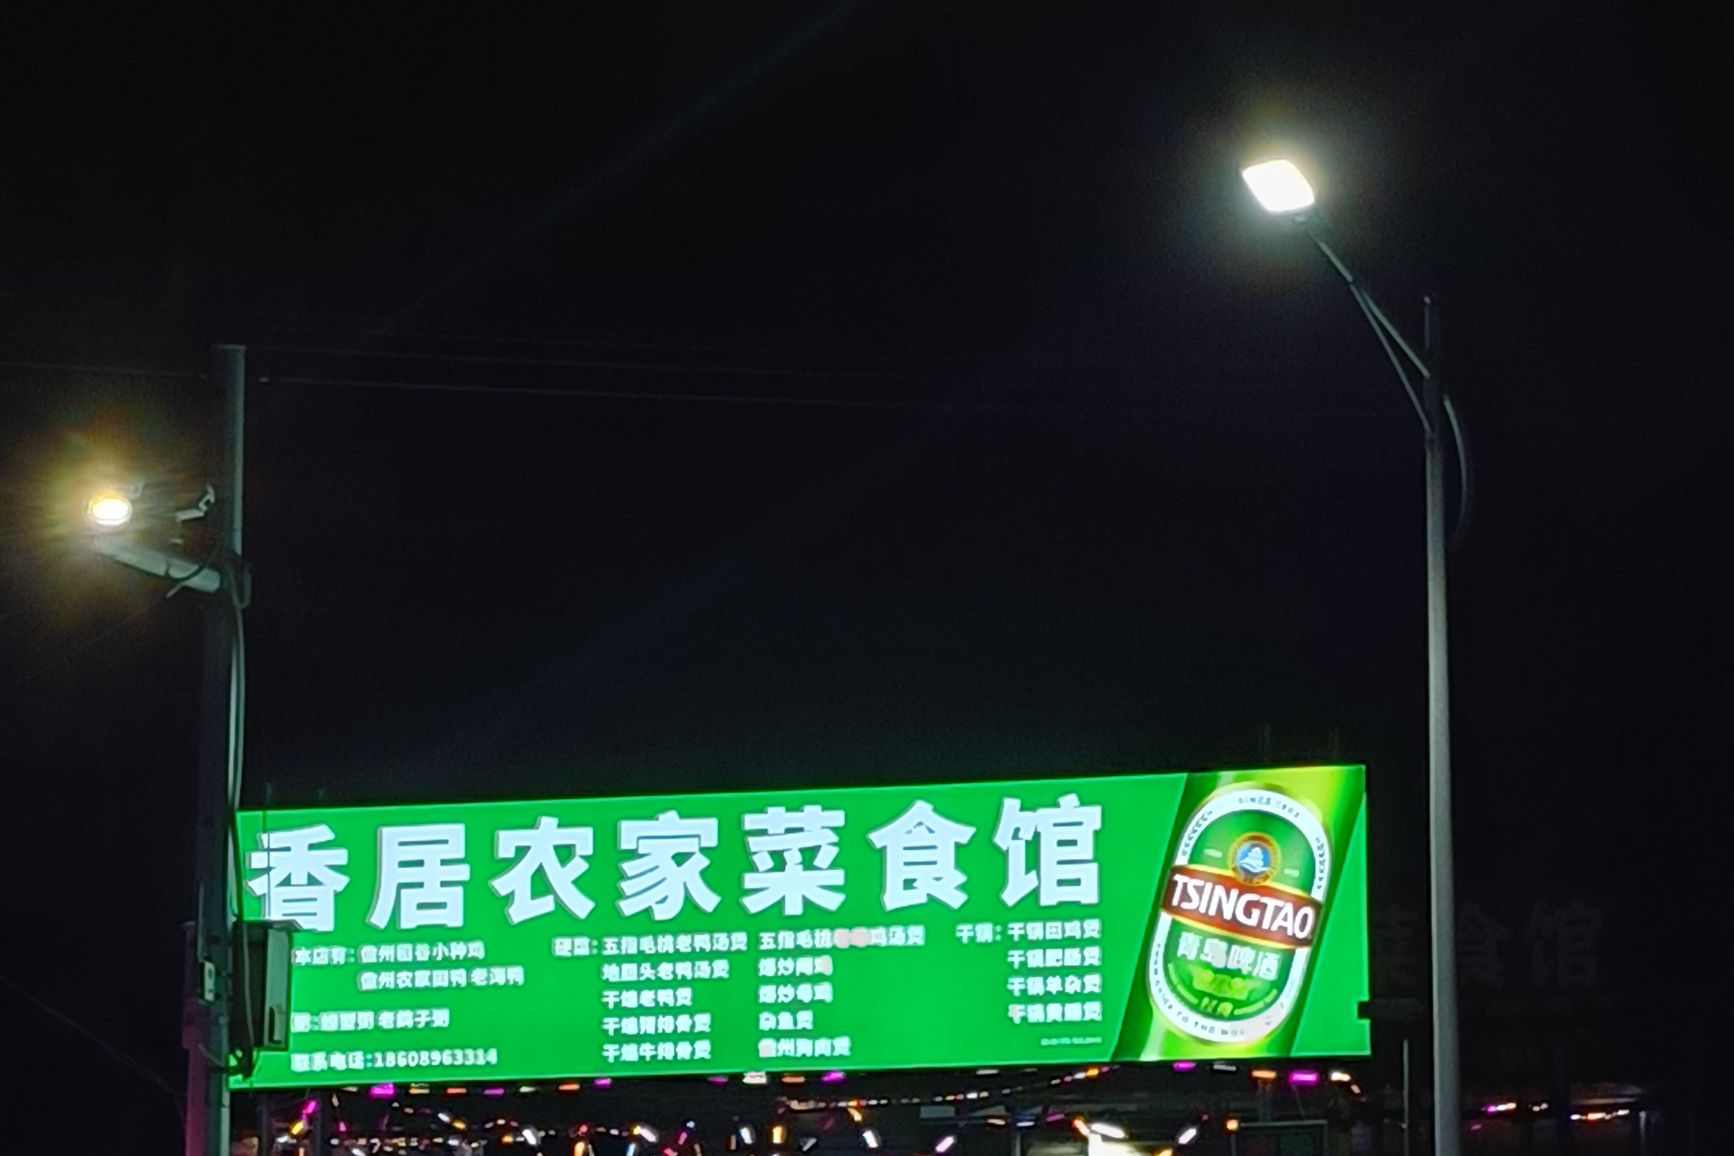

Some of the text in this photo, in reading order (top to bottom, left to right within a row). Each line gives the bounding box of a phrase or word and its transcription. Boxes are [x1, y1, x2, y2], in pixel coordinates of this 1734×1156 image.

[246, 794, 1101, 931] 香居农家菜食馆
[1171, 874, 1314, 939] TSINGTAO
